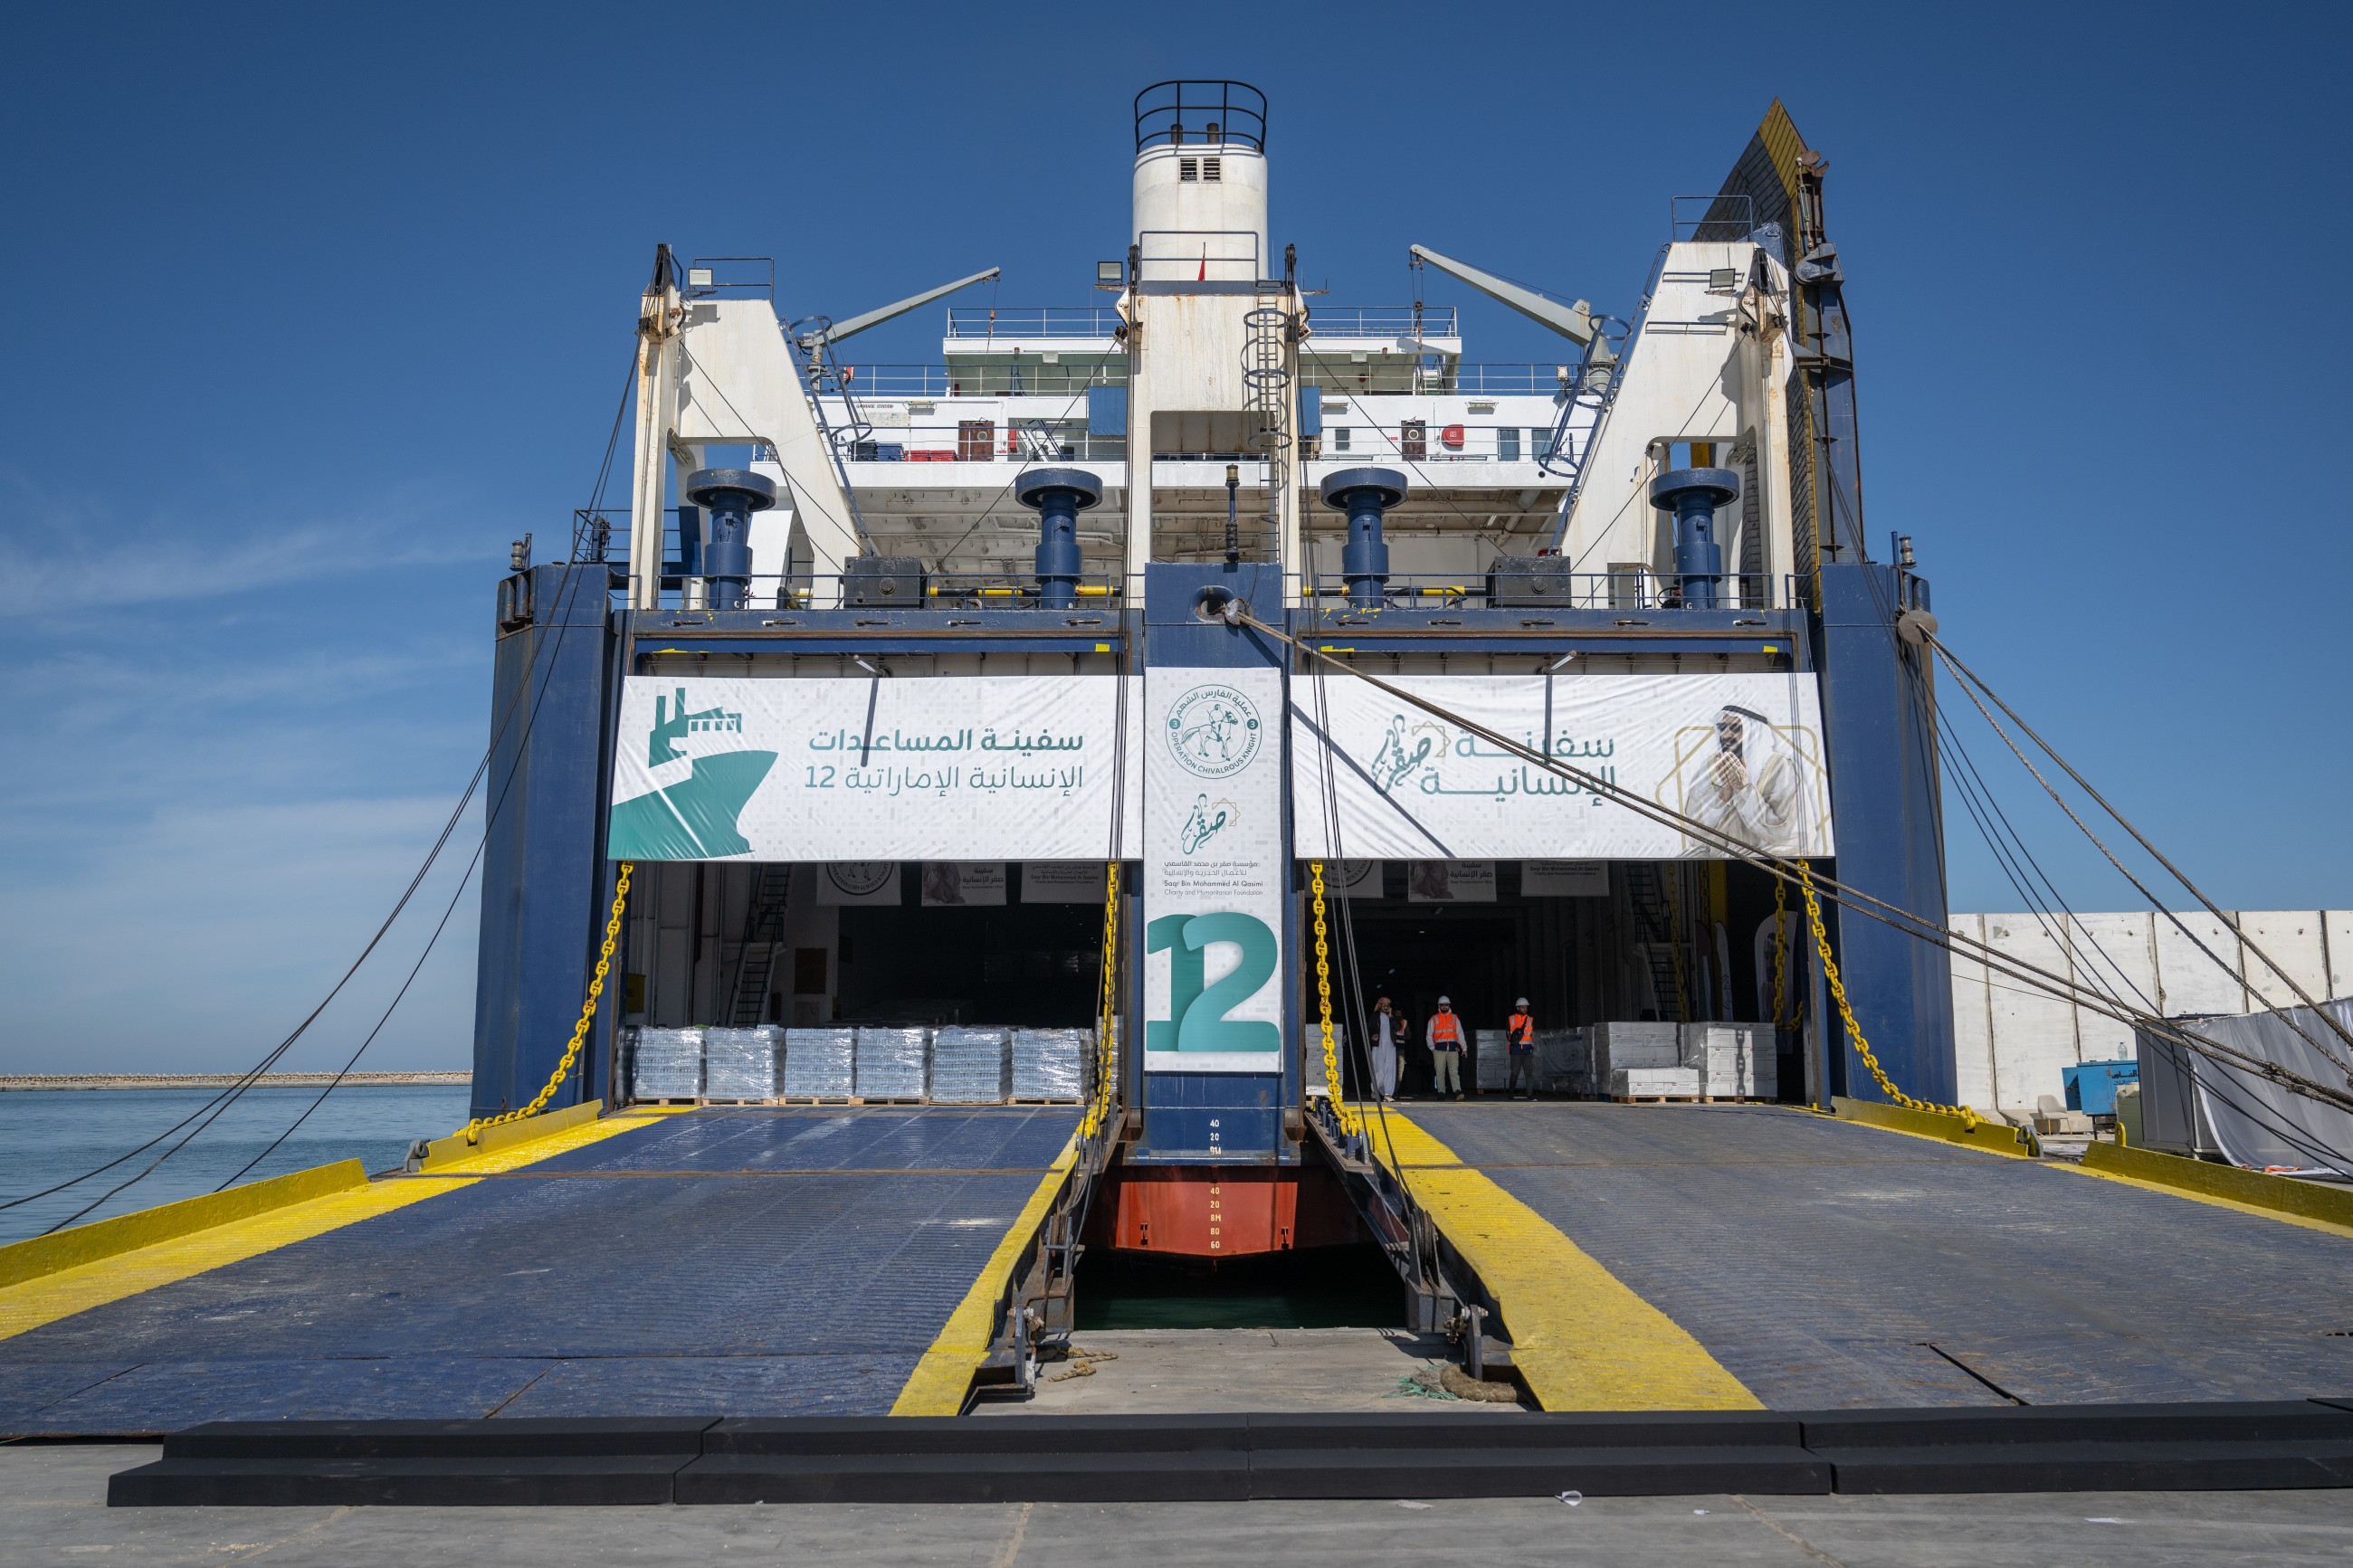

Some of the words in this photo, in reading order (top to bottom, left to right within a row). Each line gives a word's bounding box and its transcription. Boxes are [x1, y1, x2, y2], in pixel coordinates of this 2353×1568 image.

[1176, 692, 1200, 718] الشهم
[1201, 689, 1232, 699] الفارس
[1232, 695, 1251, 717] عملية
[809, 728, 972, 751] المساعدات
[981, 728, 1083, 757] سفينة
[1171, 732, 1197, 769] OPERATION
[1197, 759, 1244, 774] CHIVALROUS
[1243, 732, 1257, 760] KNIGHT
[1455, 729, 1615, 765] سفينة
[805, 765, 836, 788] 12
[845, 765, 959, 797] الإماراتية
[969, 765, 1083, 797] الإنسانية
[1420, 765, 1616, 807] الإنسانية
[1146, 911, 1280, 1052] 12
[1210, 1119, 1219, 1127] 40
[1210, 1133, 1219, 1141] 20
